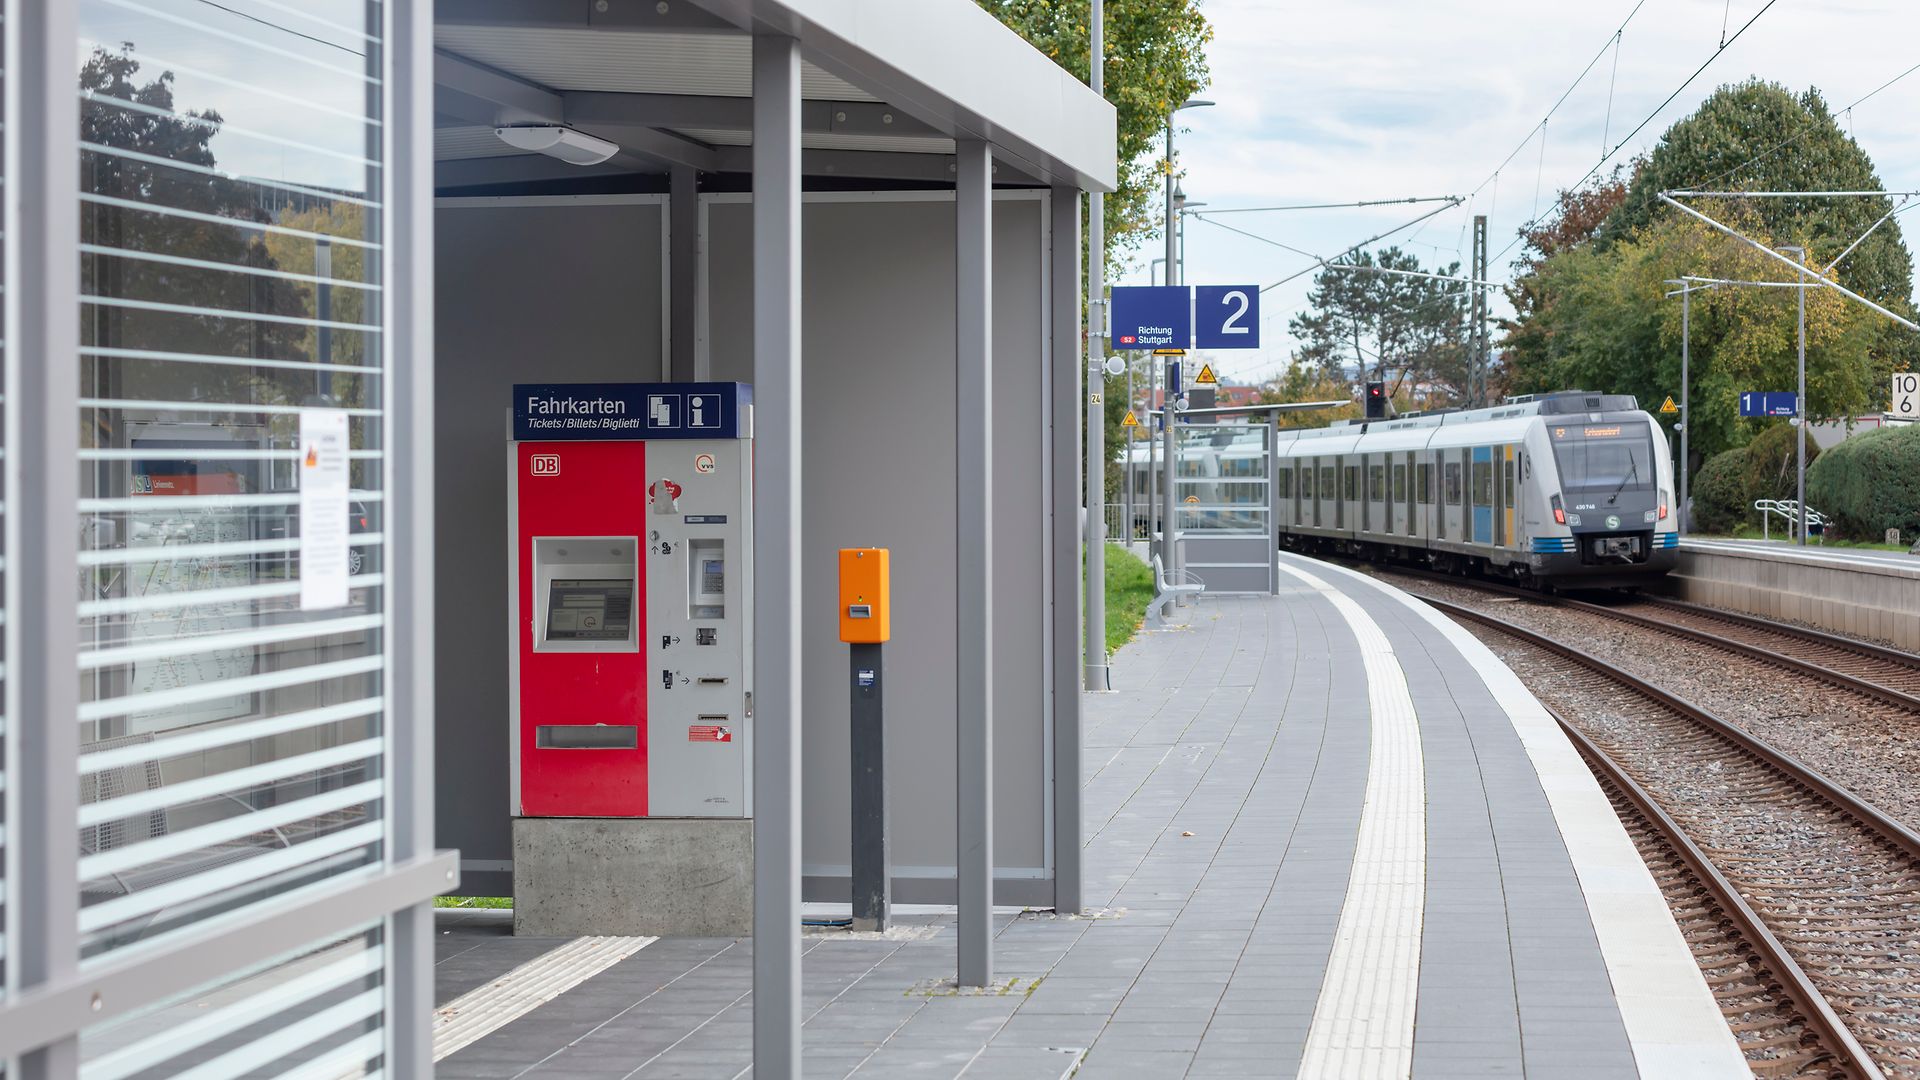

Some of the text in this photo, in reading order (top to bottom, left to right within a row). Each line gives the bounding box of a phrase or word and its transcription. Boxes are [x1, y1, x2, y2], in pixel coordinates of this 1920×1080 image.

[1221, 290, 1250, 334] 2
[1138, 326, 1173, 336] Richtung
[1138, 336, 1173, 346] Stuttgart
[1895, 376, 1917, 393] 10
[528, 396, 626, 414] Fahrkarten
[1091, 394, 1101, 404] 24
[1742, 393, 1751, 411] 1
[1900, 396, 1912, 413] 6
[534, 457, 558, 473] DB
[1607, 516, 1619, 528] S
